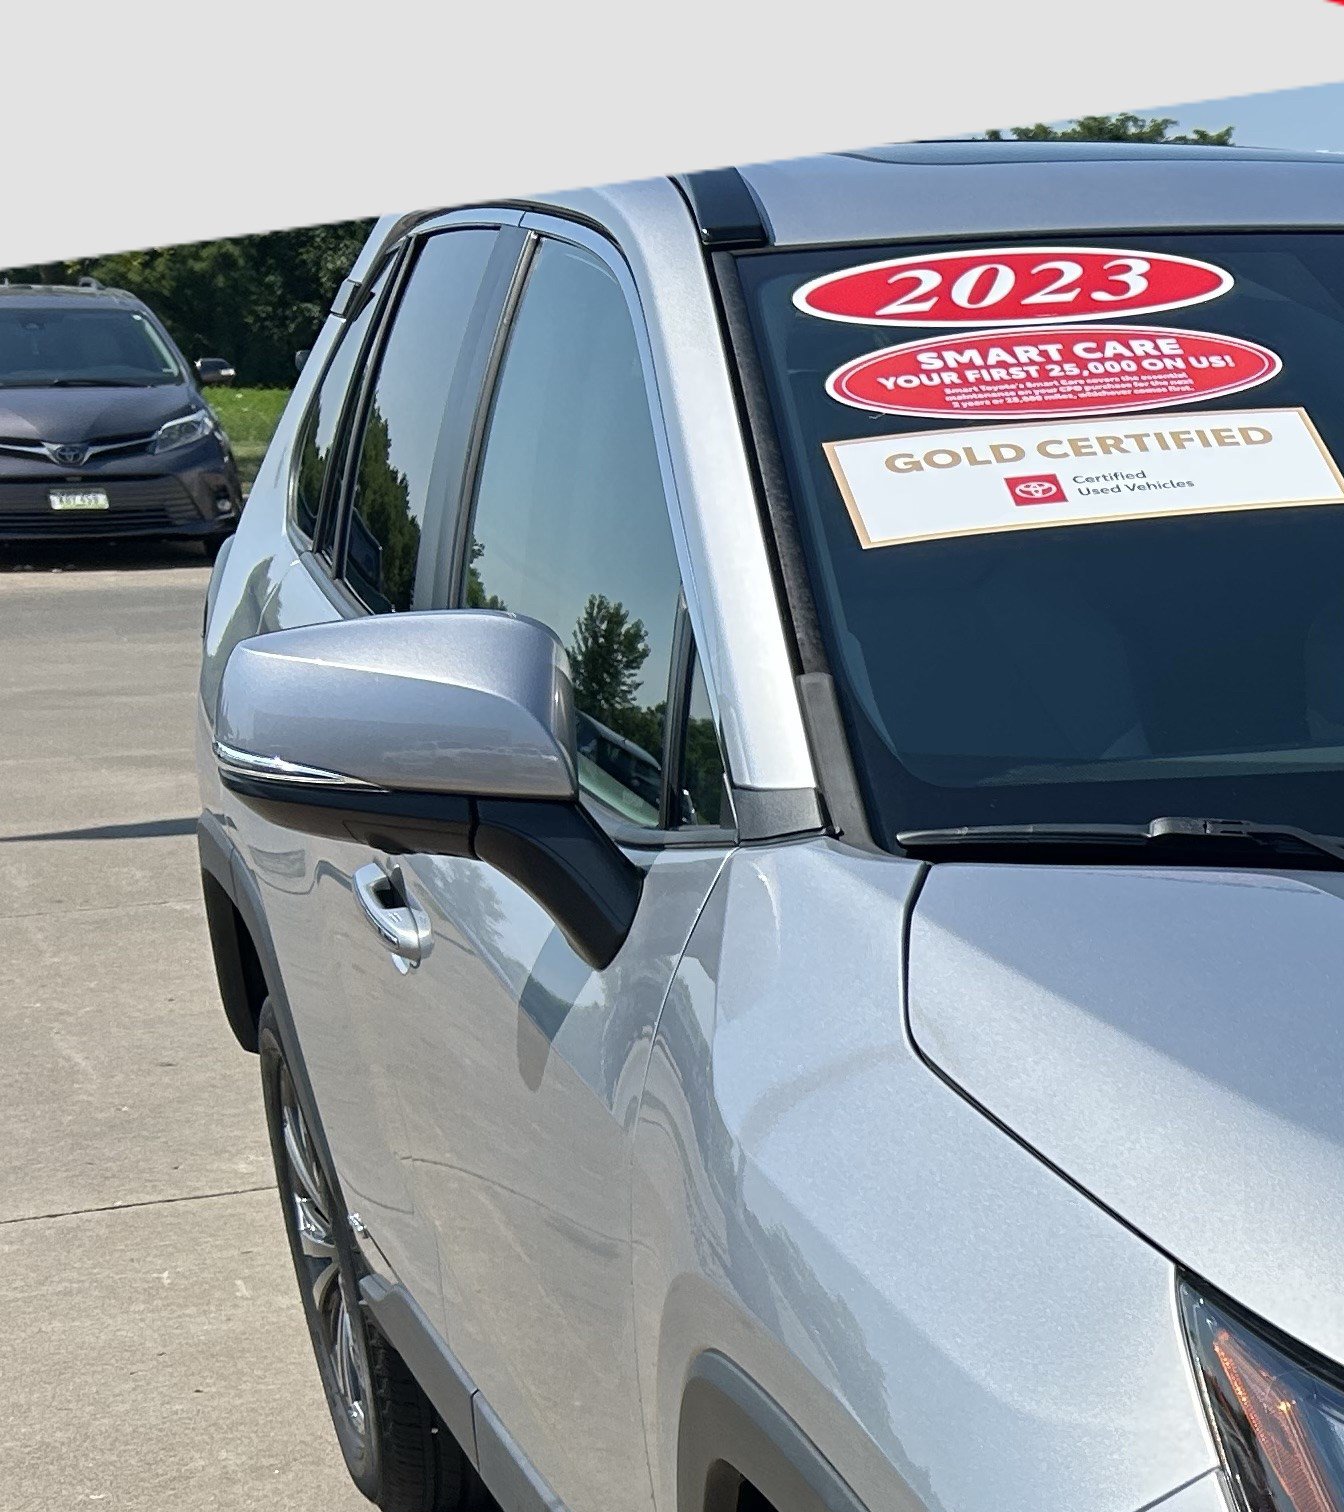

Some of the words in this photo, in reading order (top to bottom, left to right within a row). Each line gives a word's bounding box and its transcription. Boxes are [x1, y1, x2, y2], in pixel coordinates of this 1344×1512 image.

[875, 258, 1152, 316] 2023
[916, 343, 1063, 370] SMART
[1072, 337, 1185, 359] CARE
[876, 371, 963, 391] YOUR
[964, 365, 1040, 384] FIRST
[1141, 357, 1187, 371] ON
[1187, 355, 1236, 369] US!
[884, 442, 1027, 475] GOLD
[1035, 425, 1275, 460] CERTIFIED
[1072, 469, 1148, 485] Certified
[1077, 483, 1122, 497] Used
[1123, 479, 1196, 493] Vehicles
